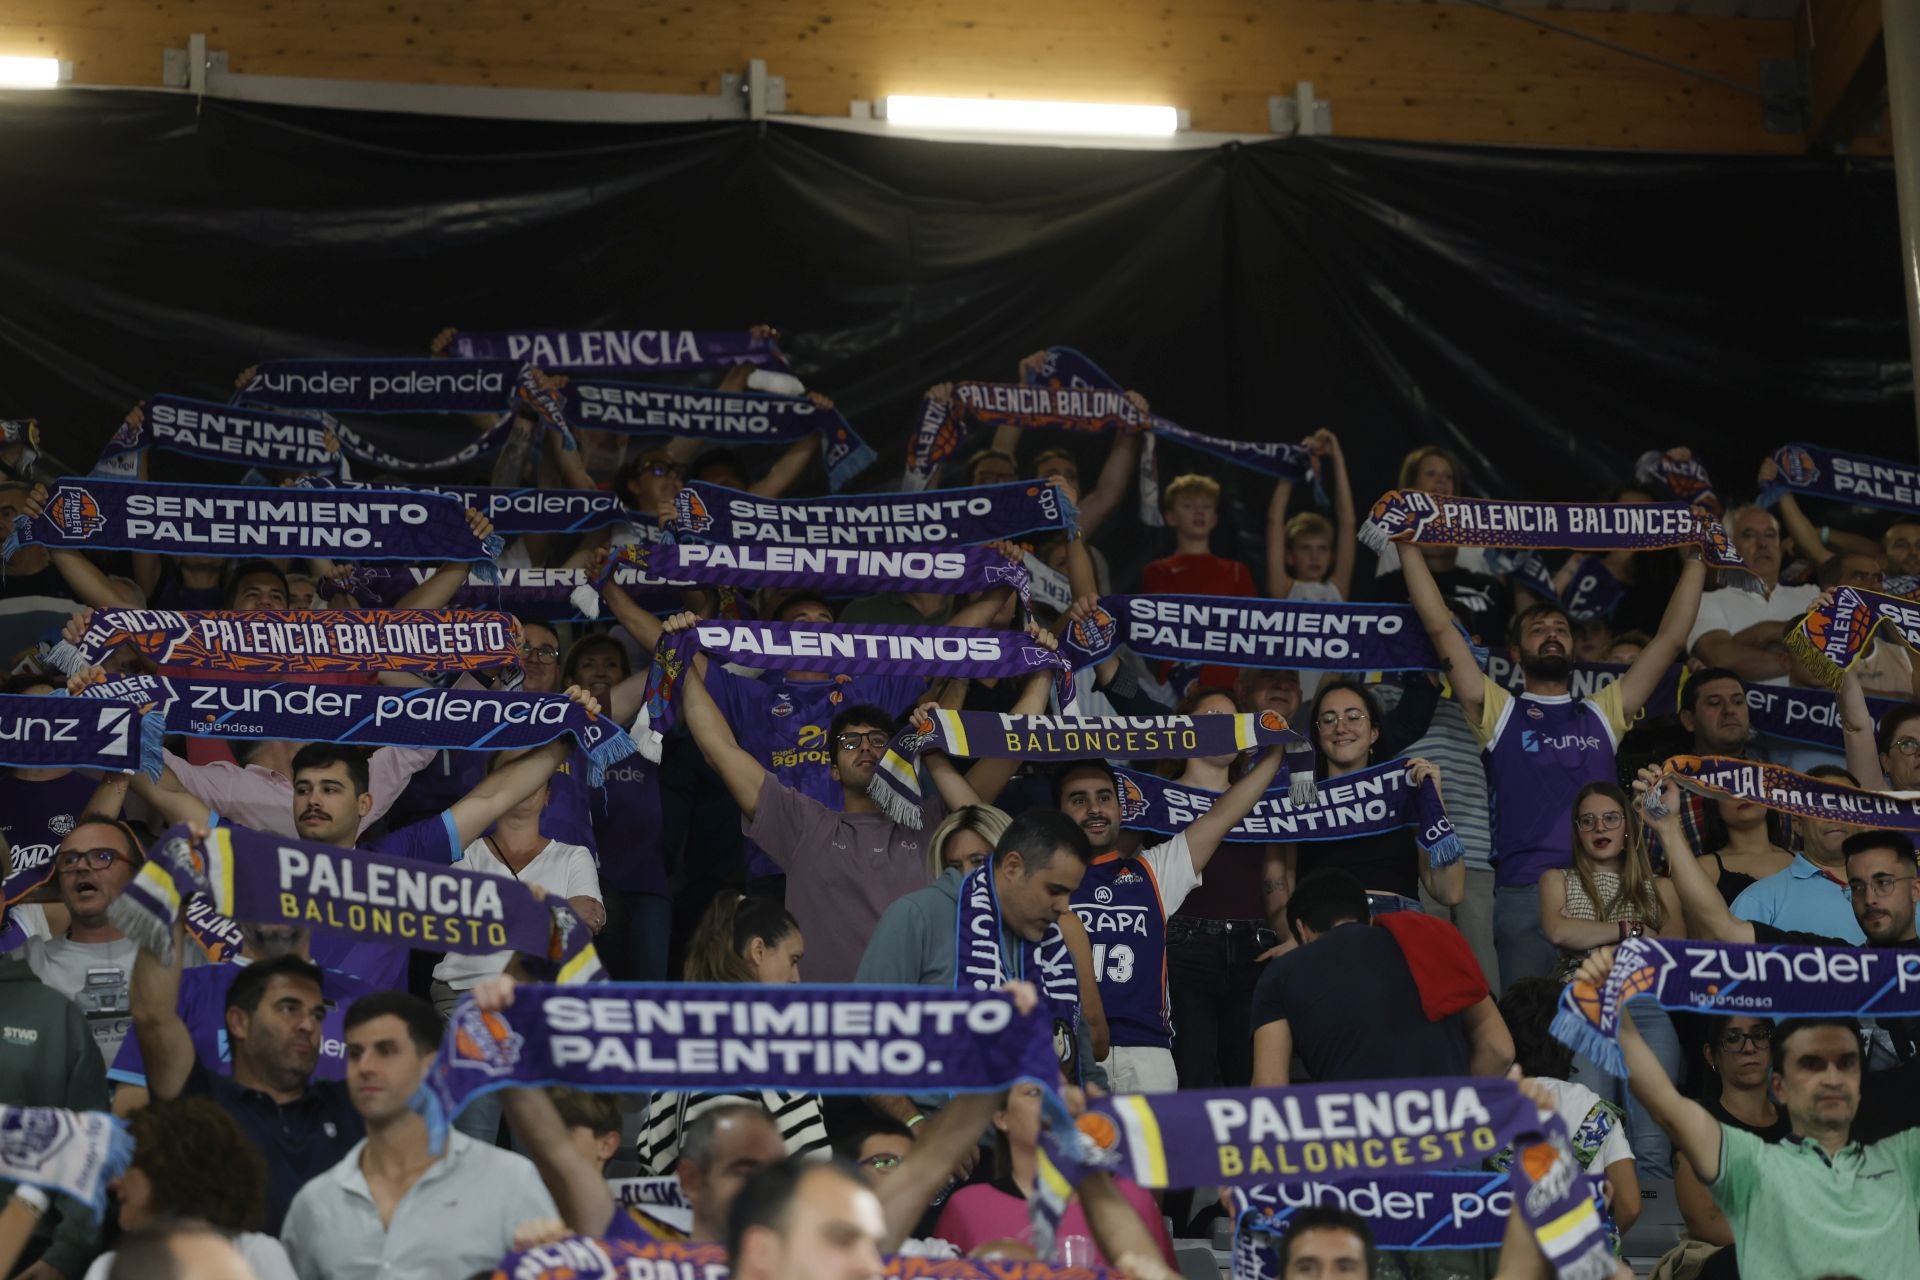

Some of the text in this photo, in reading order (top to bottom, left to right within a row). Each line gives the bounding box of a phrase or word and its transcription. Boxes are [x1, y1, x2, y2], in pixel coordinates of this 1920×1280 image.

[507, 330, 703, 367] PALENCIA
[246, 369, 503, 400] zunder palencia
[577, 384, 816, 416] SENTIMIENTO
[957, 385, 1051, 414] PALENCIA
[580, 402, 779, 433] PALENTINO.
[64, 498, 72, 528] PALENCIA
[70, 491, 83, 534] ZUNDER
[126, 495, 428, 524] SENTIMIENTO
[680, 492, 692, 529] ZUNDER
[729, 497, 993, 525] SENTIMIENTO
[1039, 488, 1058, 520] acb
[1443, 504, 1559, 534] PALENCIA
[126, 519, 383, 548] PALENTINO.
[731, 521, 959, 545] PALENTINO.
[678, 544, 966, 580] PALENTINOS
[1129, 598, 1403, 635] SENTIMIENTO
[80, 610, 181, 662] PALENCIA
[200, 619, 505, 654] PALENCIA BALONCESTO
[695, 626, 1002, 662] PALENTINOS
[1129, 622, 1361, 659] PALENTINO.
[190, 684, 570, 726] zunder palencia
[1006, 730, 1197, 752] BALONCESTO
[1168, 799, 1396, 834] PENTINO.
[277, 846, 505, 919] PALENCIA
[280, 892, 507, 946] BALONCESTO
[1092, 943, 1135, 983] 13
[1685, 947, 1879, 983] zunder
[3, 1026, 38, 1041] STWD
[542, 996, 1013, 1036] SENTIMIENTO
[547, 1033, 944, 1076] PALENTINO.
[1204, 1087, 1492, 1144] PALENCIA
[1217, 1127, 1497, 1178] BALONCESTO
